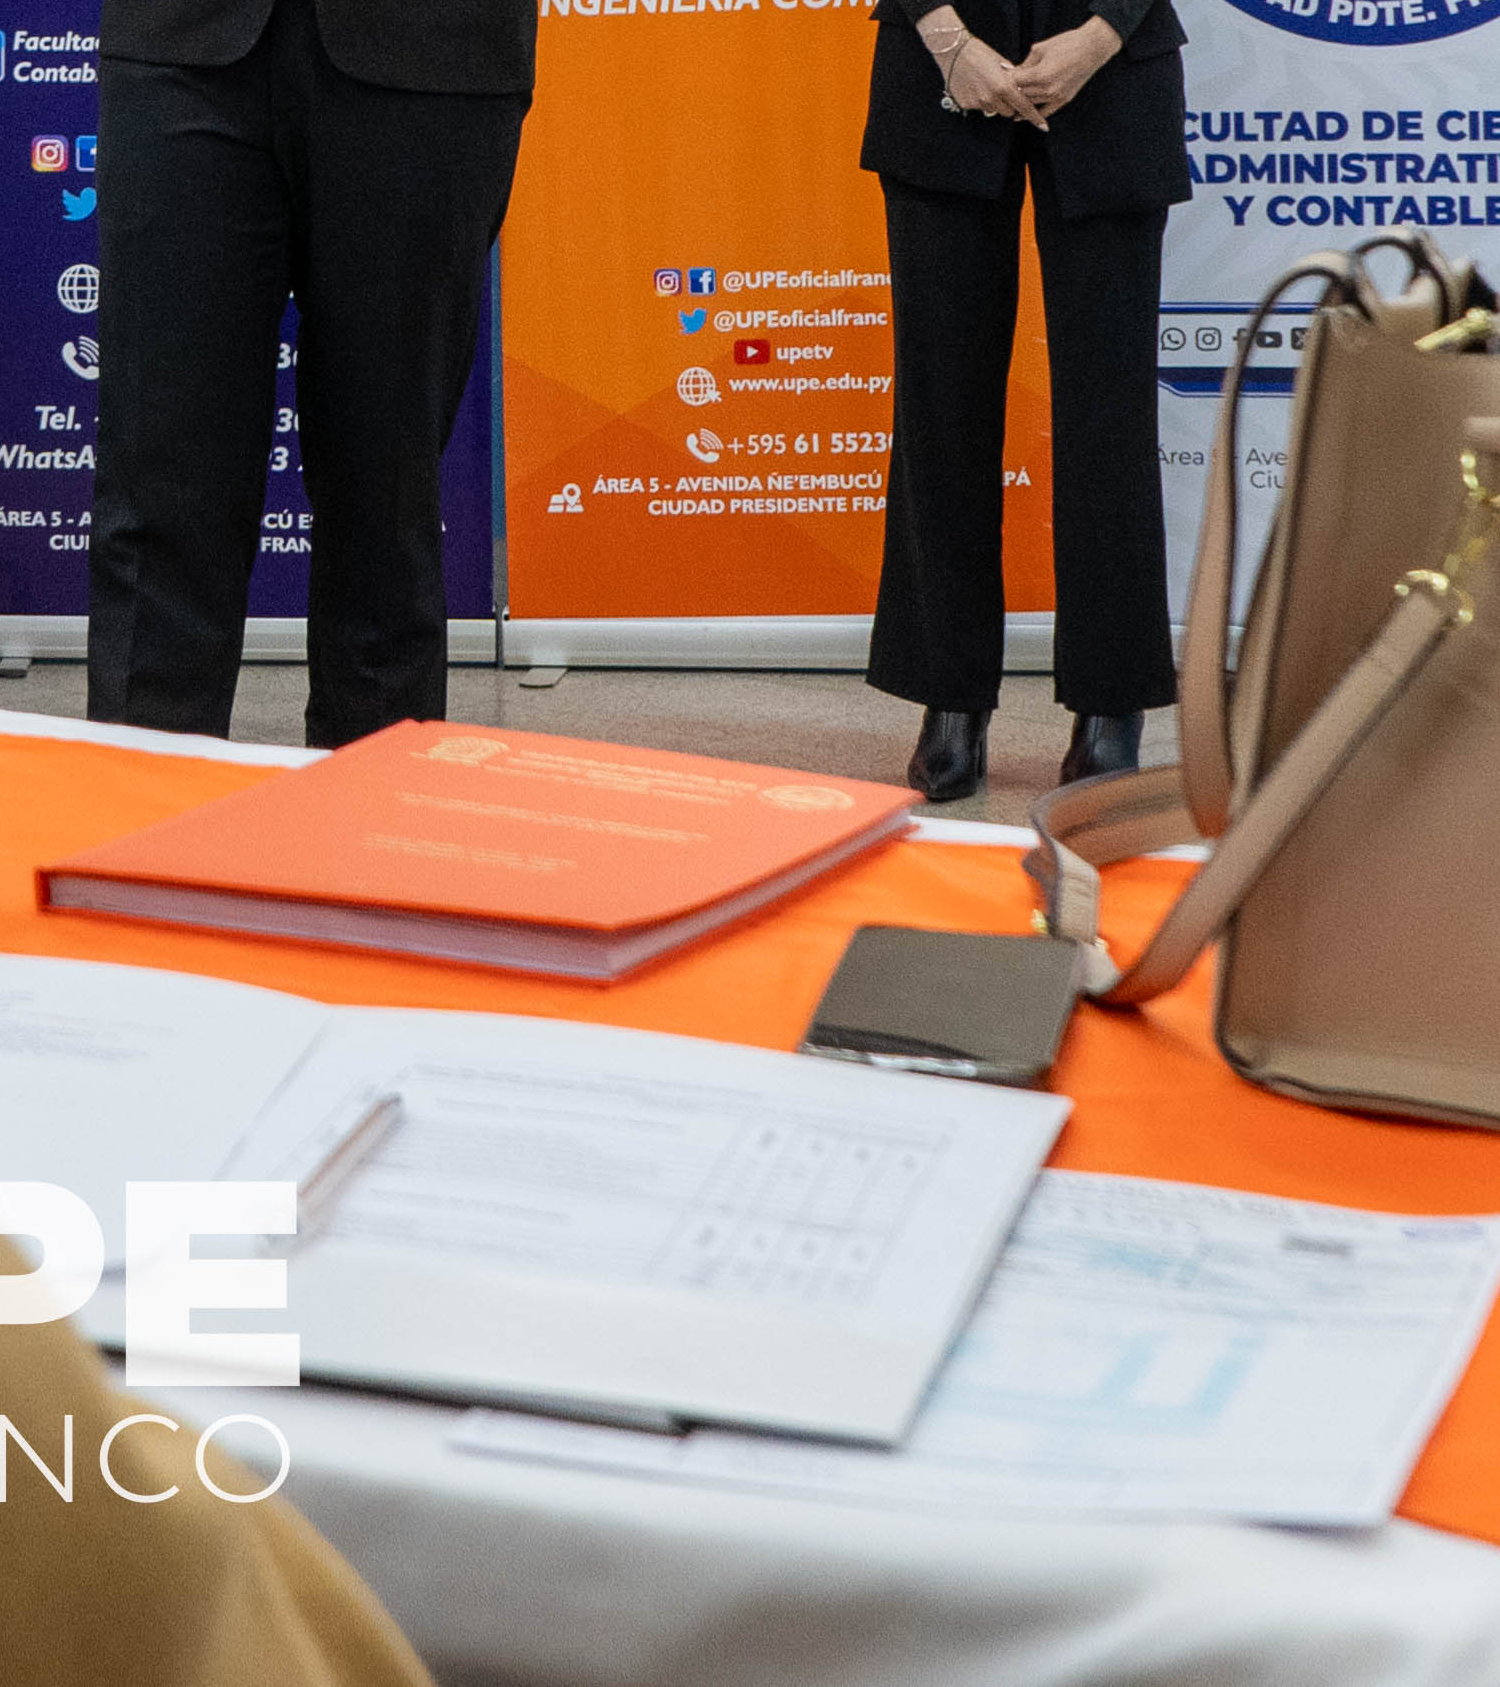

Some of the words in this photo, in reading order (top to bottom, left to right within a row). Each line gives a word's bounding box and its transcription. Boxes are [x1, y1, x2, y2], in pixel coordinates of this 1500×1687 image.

[1362, 110, 1423, 141] DE
[1222, 195, 1253, 226] Y
[776, 343, 834, 364] upetv
[728, 372, 893, 395] www.upe.edu.py
[35, 405, 82, 432] Tel.
[727, 433, 787, 456] +595
[793, 433, 820, 454] 61
[592, 474, 645, 494] ÁREA
[649, 477, 659, 493] 5
[675, 475, 763, 492] AVENIDA
[648, 498, 726, 516] CIUDAD
[730, 496, 848, 514] PRESIDENTE
[51, 511, 62, 527] 5
